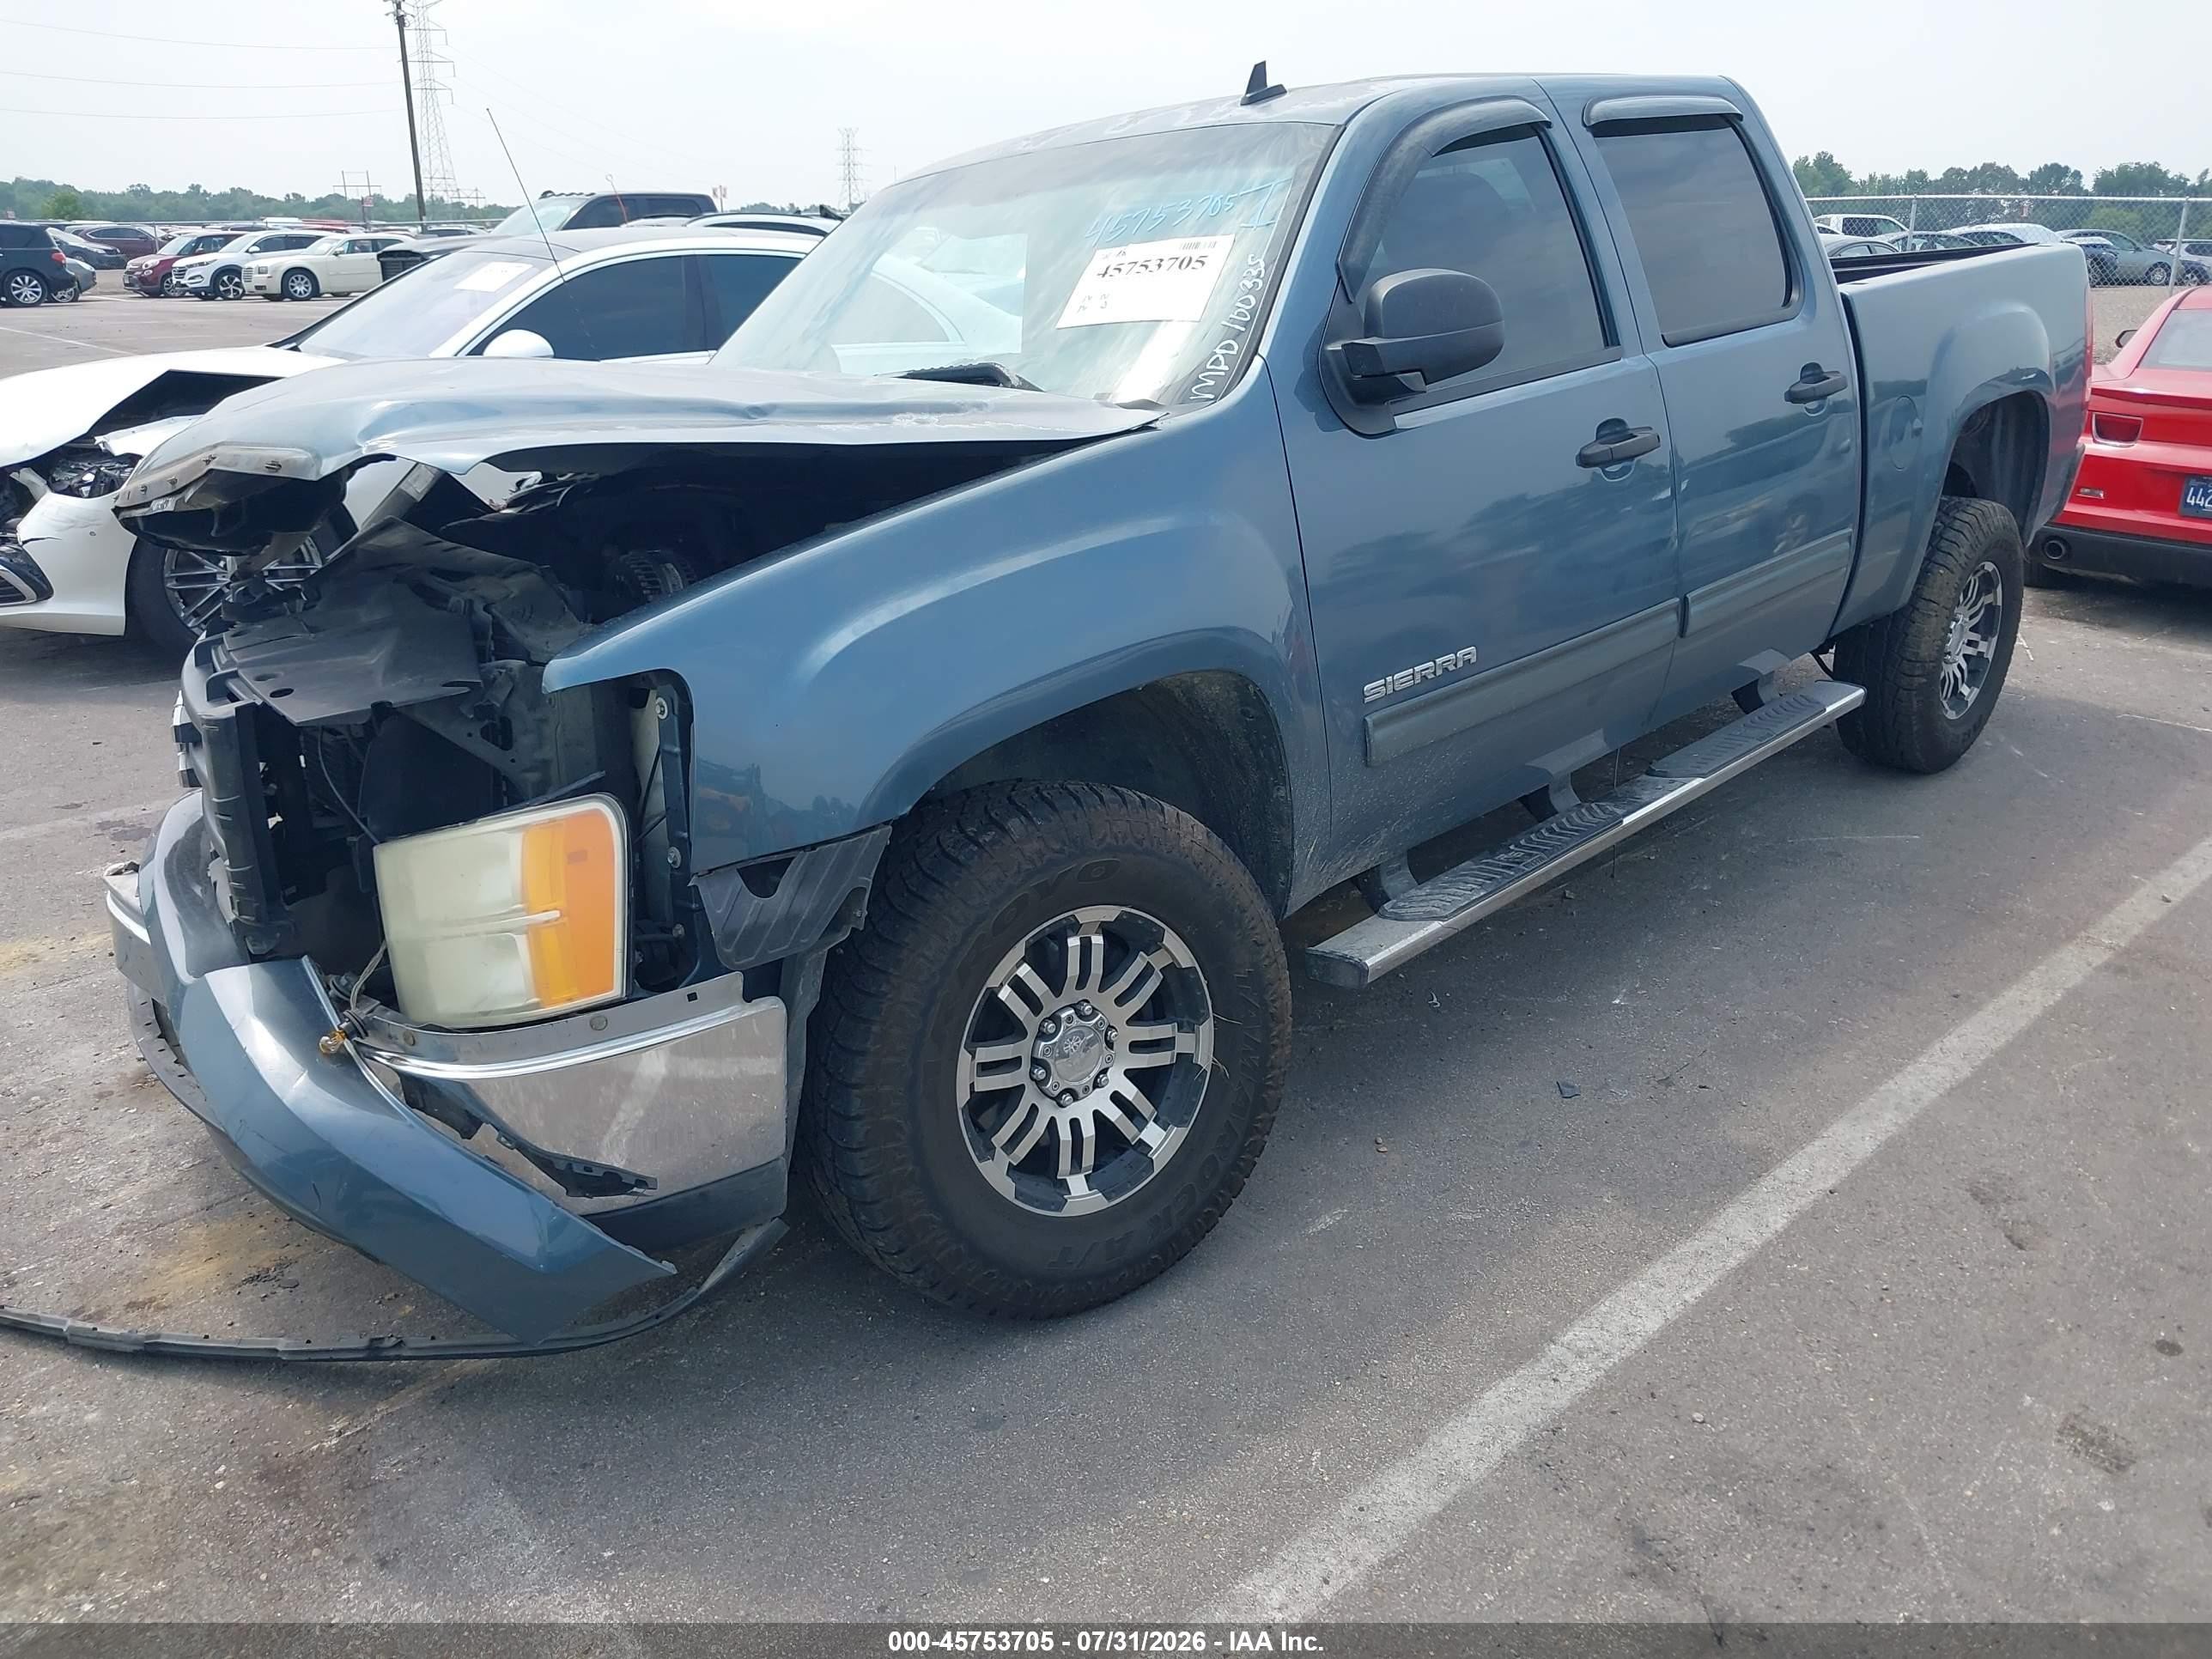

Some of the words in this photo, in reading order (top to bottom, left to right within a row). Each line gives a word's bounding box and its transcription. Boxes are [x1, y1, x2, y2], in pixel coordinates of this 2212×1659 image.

[1085, 194, 1237, 246] 45753705
[1097, 255, 1208, 278] 45753705
[1189, 340, 1238, 400] MPD
[1364, 646, 1477, 704] SIERRA
